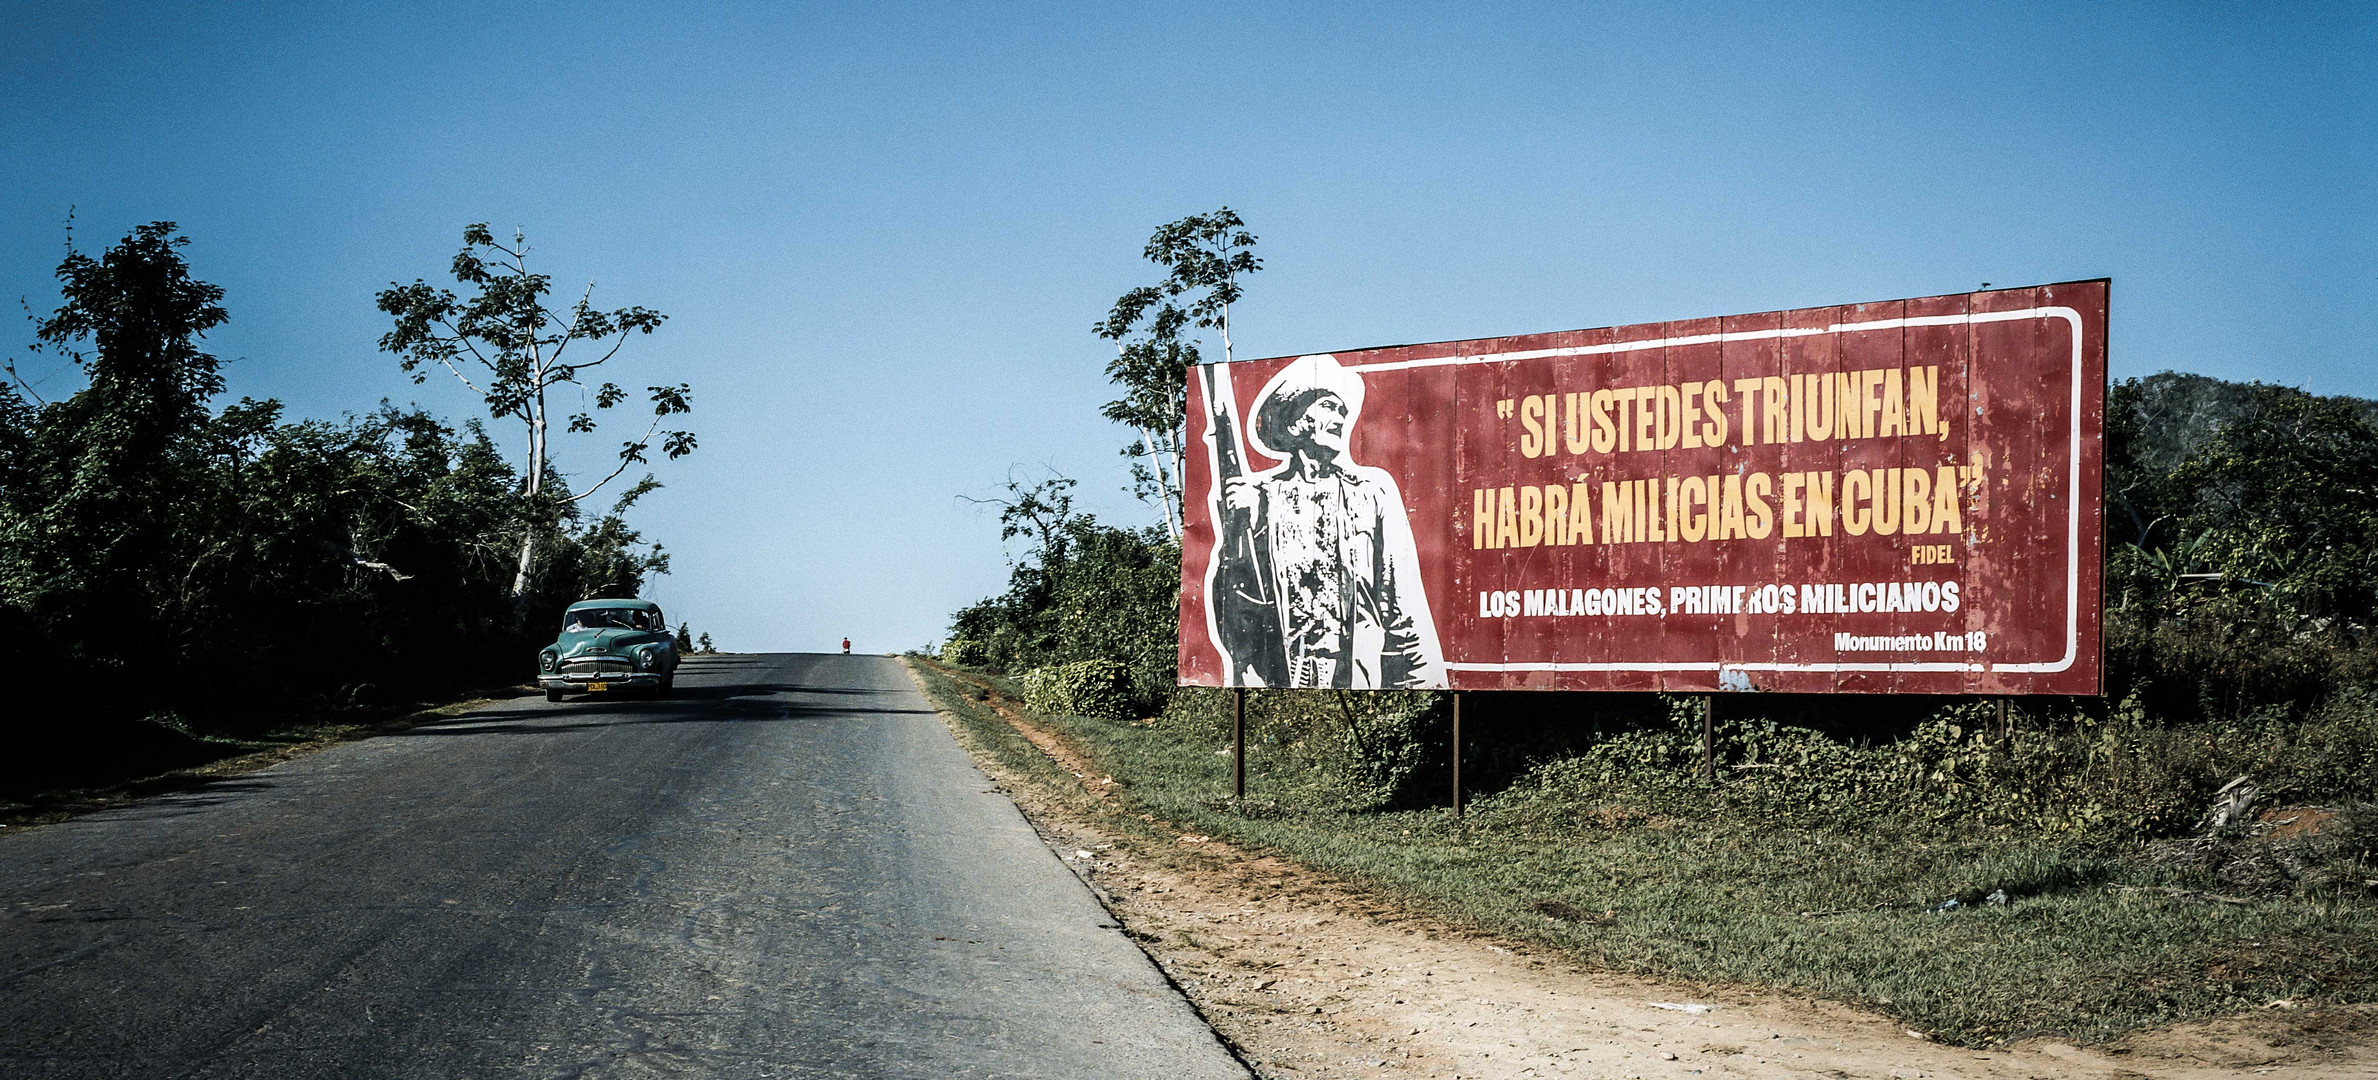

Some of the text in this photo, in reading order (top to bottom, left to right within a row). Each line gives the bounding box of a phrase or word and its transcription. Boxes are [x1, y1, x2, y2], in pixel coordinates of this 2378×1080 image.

[1566, 379, 1728, 455] USTEDES
[1734, 366, 1949, 446] TRIUNFAN,
[1474, 473, 1593, 549] HABRÁ
[1602, 472, 1773, 543] MILICIAS
[1783, 471, 1832, 537] EN
[1911, 545, 1955, 565] FIDEL
[1480, 591, 1520, 618] LOS
[1524, 588, 1666, 619] MALAGONES,
[1800, 581, 1960, 614] MILICIANOS
[1834, 631, 1987, 652] Monumento Km 18
